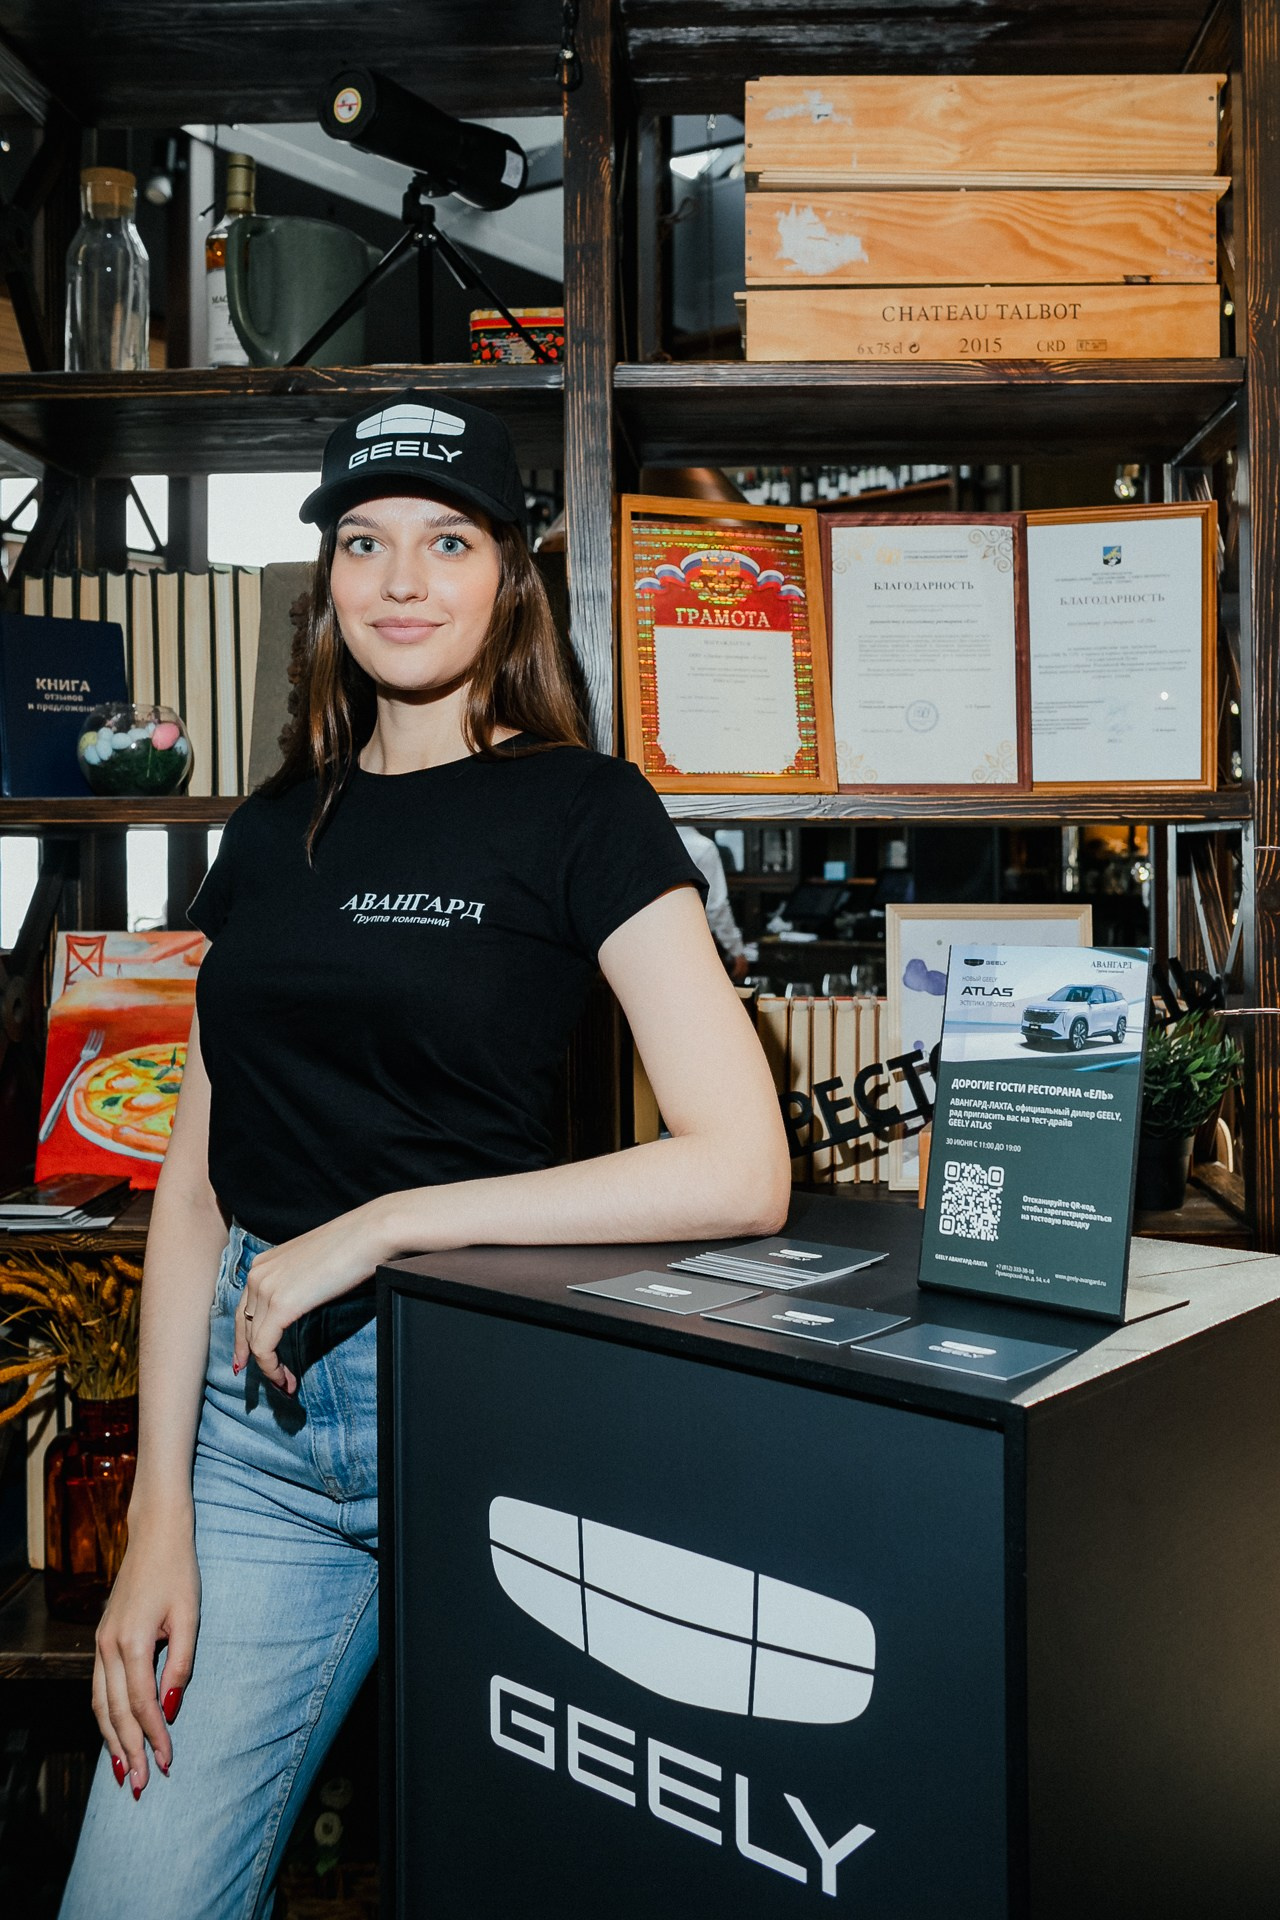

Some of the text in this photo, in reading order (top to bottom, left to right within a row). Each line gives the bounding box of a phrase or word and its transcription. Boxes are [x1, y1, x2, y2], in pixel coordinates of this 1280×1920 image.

[882, 303, 1082, 322] CHATEAU TALBOT
[959, 338, 1002, 353] 2015
[1037, 339, 1066, 352] CRD
[348, 440, 463, 469] GEELY
[873, 580, 974, 591] БЛАГОДАРНОСТЬ
[1060, 593, 1165, 606] БЛАГОДАРНОСТЬ
[675, 607, 771, 628] ГРАМОТА
[35, 677, 91, 693] КНИГА
[36, 703, 97, 713] предложени
[339, 893, 485, 925] АВАНГАРД
[352, 913, 451, 928] Группа компаний
[1090, 960, 1133, 970] АВАНГАРД
[960, 986, 1015, 997] ATLAS
[986, 1001, 1016, 1009] ПРОГРЕССА
[951, 1078, 1114, 1101] ДОРОГИЕ ГОСТИ РЕСТОРАНА «ЕЛЬ»
[950, 1097, 1014, 1112] АВАНГАРД-ЛАХТА,
[1015, 1103, 1070, 1117] официальный
[1070, 1108, 1096, 1121] дилер
[948, 1118, 993, 1130] GEELY ATLAS
[949, 1109, 1073, 1128] рад пригласить вас на тест-драйв
[945, 1137, 1021, 1153] 30 ИЮНЯ С 11:00 ДО 19:00
[1022, 1195, 1070, 1208] Отсканируйте
[1021, 1204, 1112, 1223] чтобы зарегистрироваться
[1020, 1213, 1090, 1231] на тестовую поездку
[490, 1674, 876, 1898] GEELY
